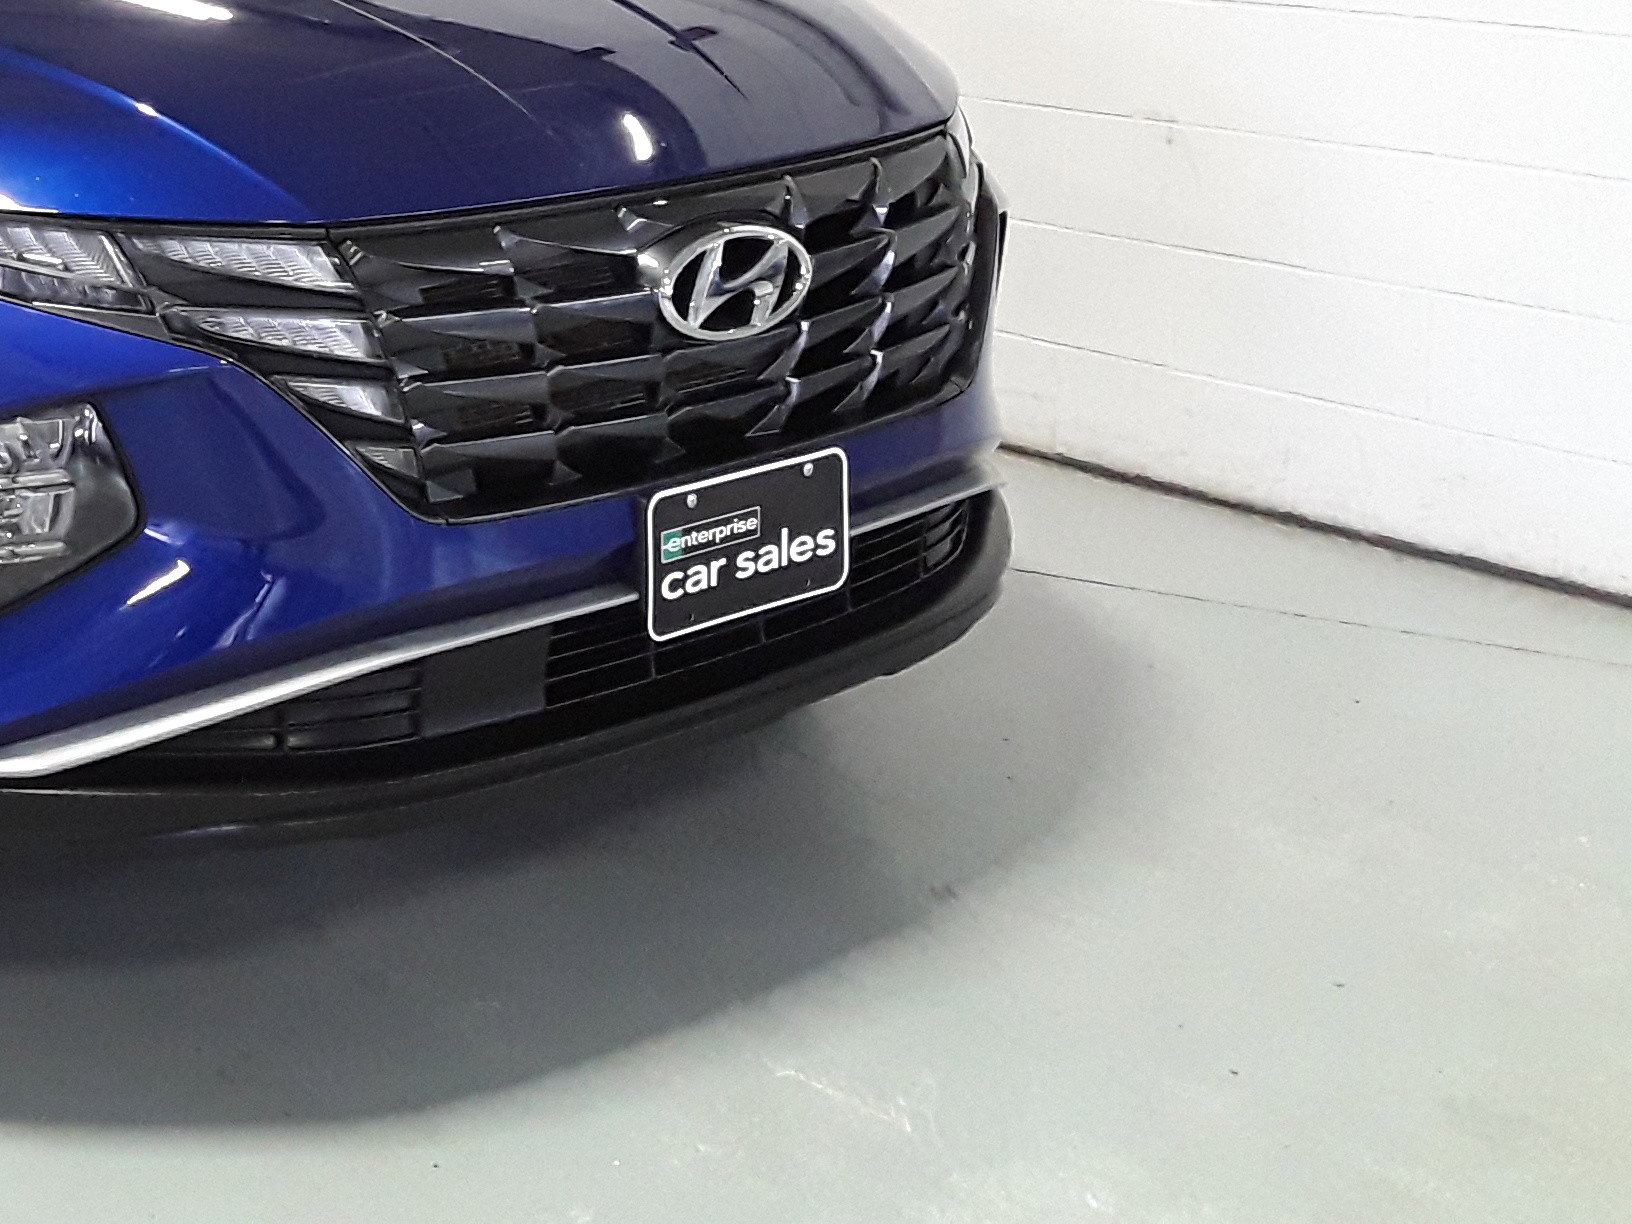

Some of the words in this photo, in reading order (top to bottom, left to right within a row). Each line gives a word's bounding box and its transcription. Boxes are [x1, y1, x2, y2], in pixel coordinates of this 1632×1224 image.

[667, 516, 758, 552] enterprise
[661, 556, 727, 600] car
[734, 527, 837, 579] sales
